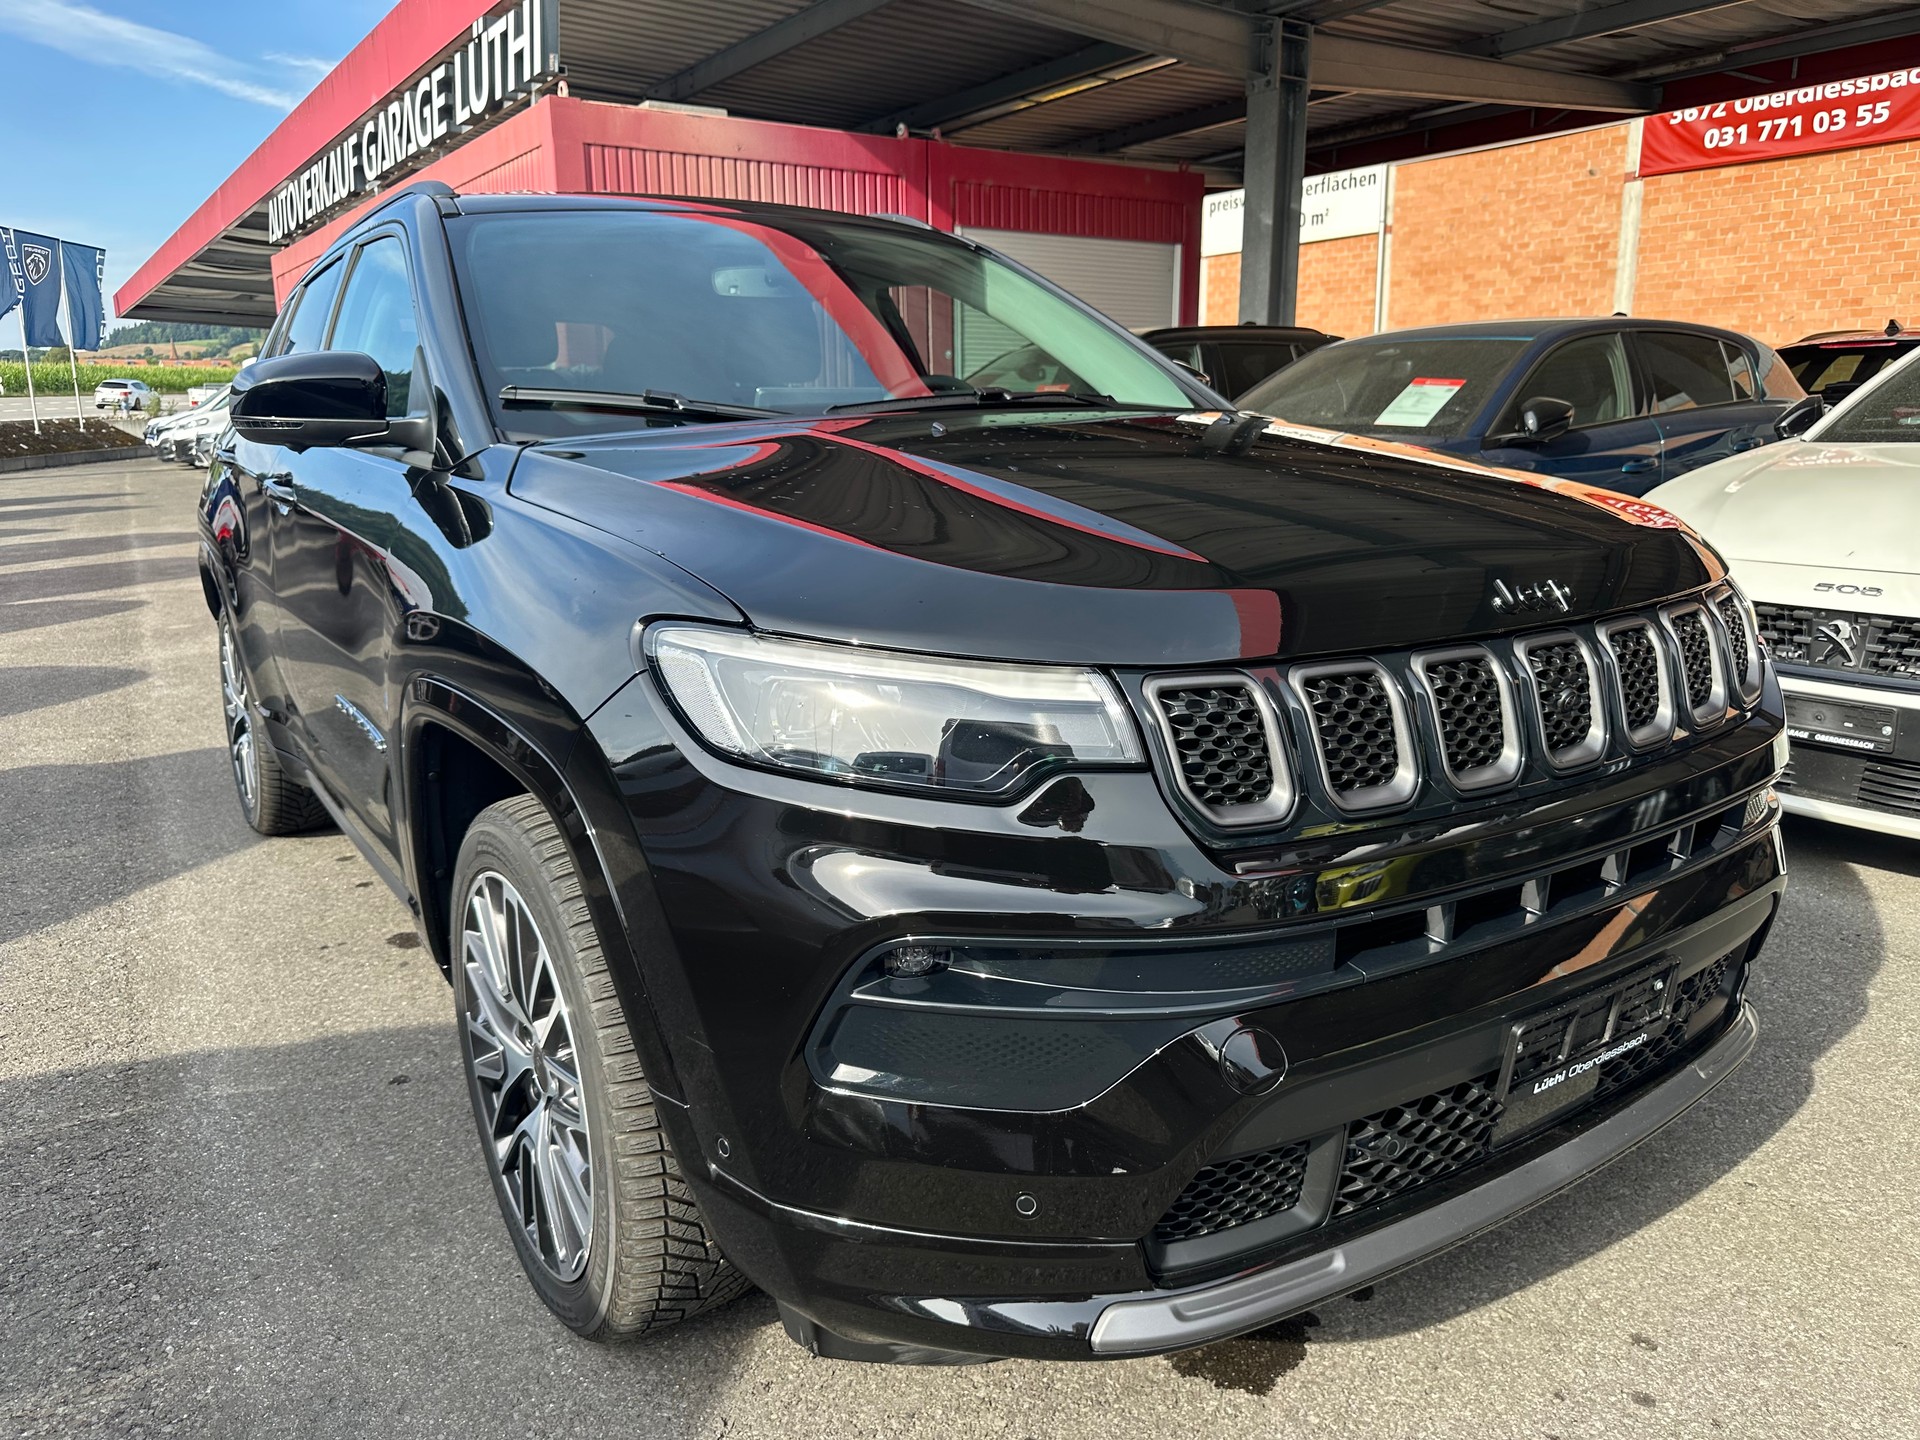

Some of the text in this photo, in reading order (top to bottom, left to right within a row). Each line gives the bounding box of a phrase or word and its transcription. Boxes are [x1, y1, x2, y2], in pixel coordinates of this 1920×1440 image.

[1733, 67, 1920, 115] Oberdiessbac
[268, 0, 542, 245] AUTOVERKAUF GARAGE LÜTHI
[1703, 100, 1892, 149] 031 771 03 55
[1304, 172, 1377, 197] erflächen
[1491, 578, 1577, 614] Jeep
[1813, 582, 1884, 598] 508
[1814, 732, 1875, 750] OBERDIESSBACH
[1533, 1032, 1648, 1095] Lüthi Oberdiessbach
